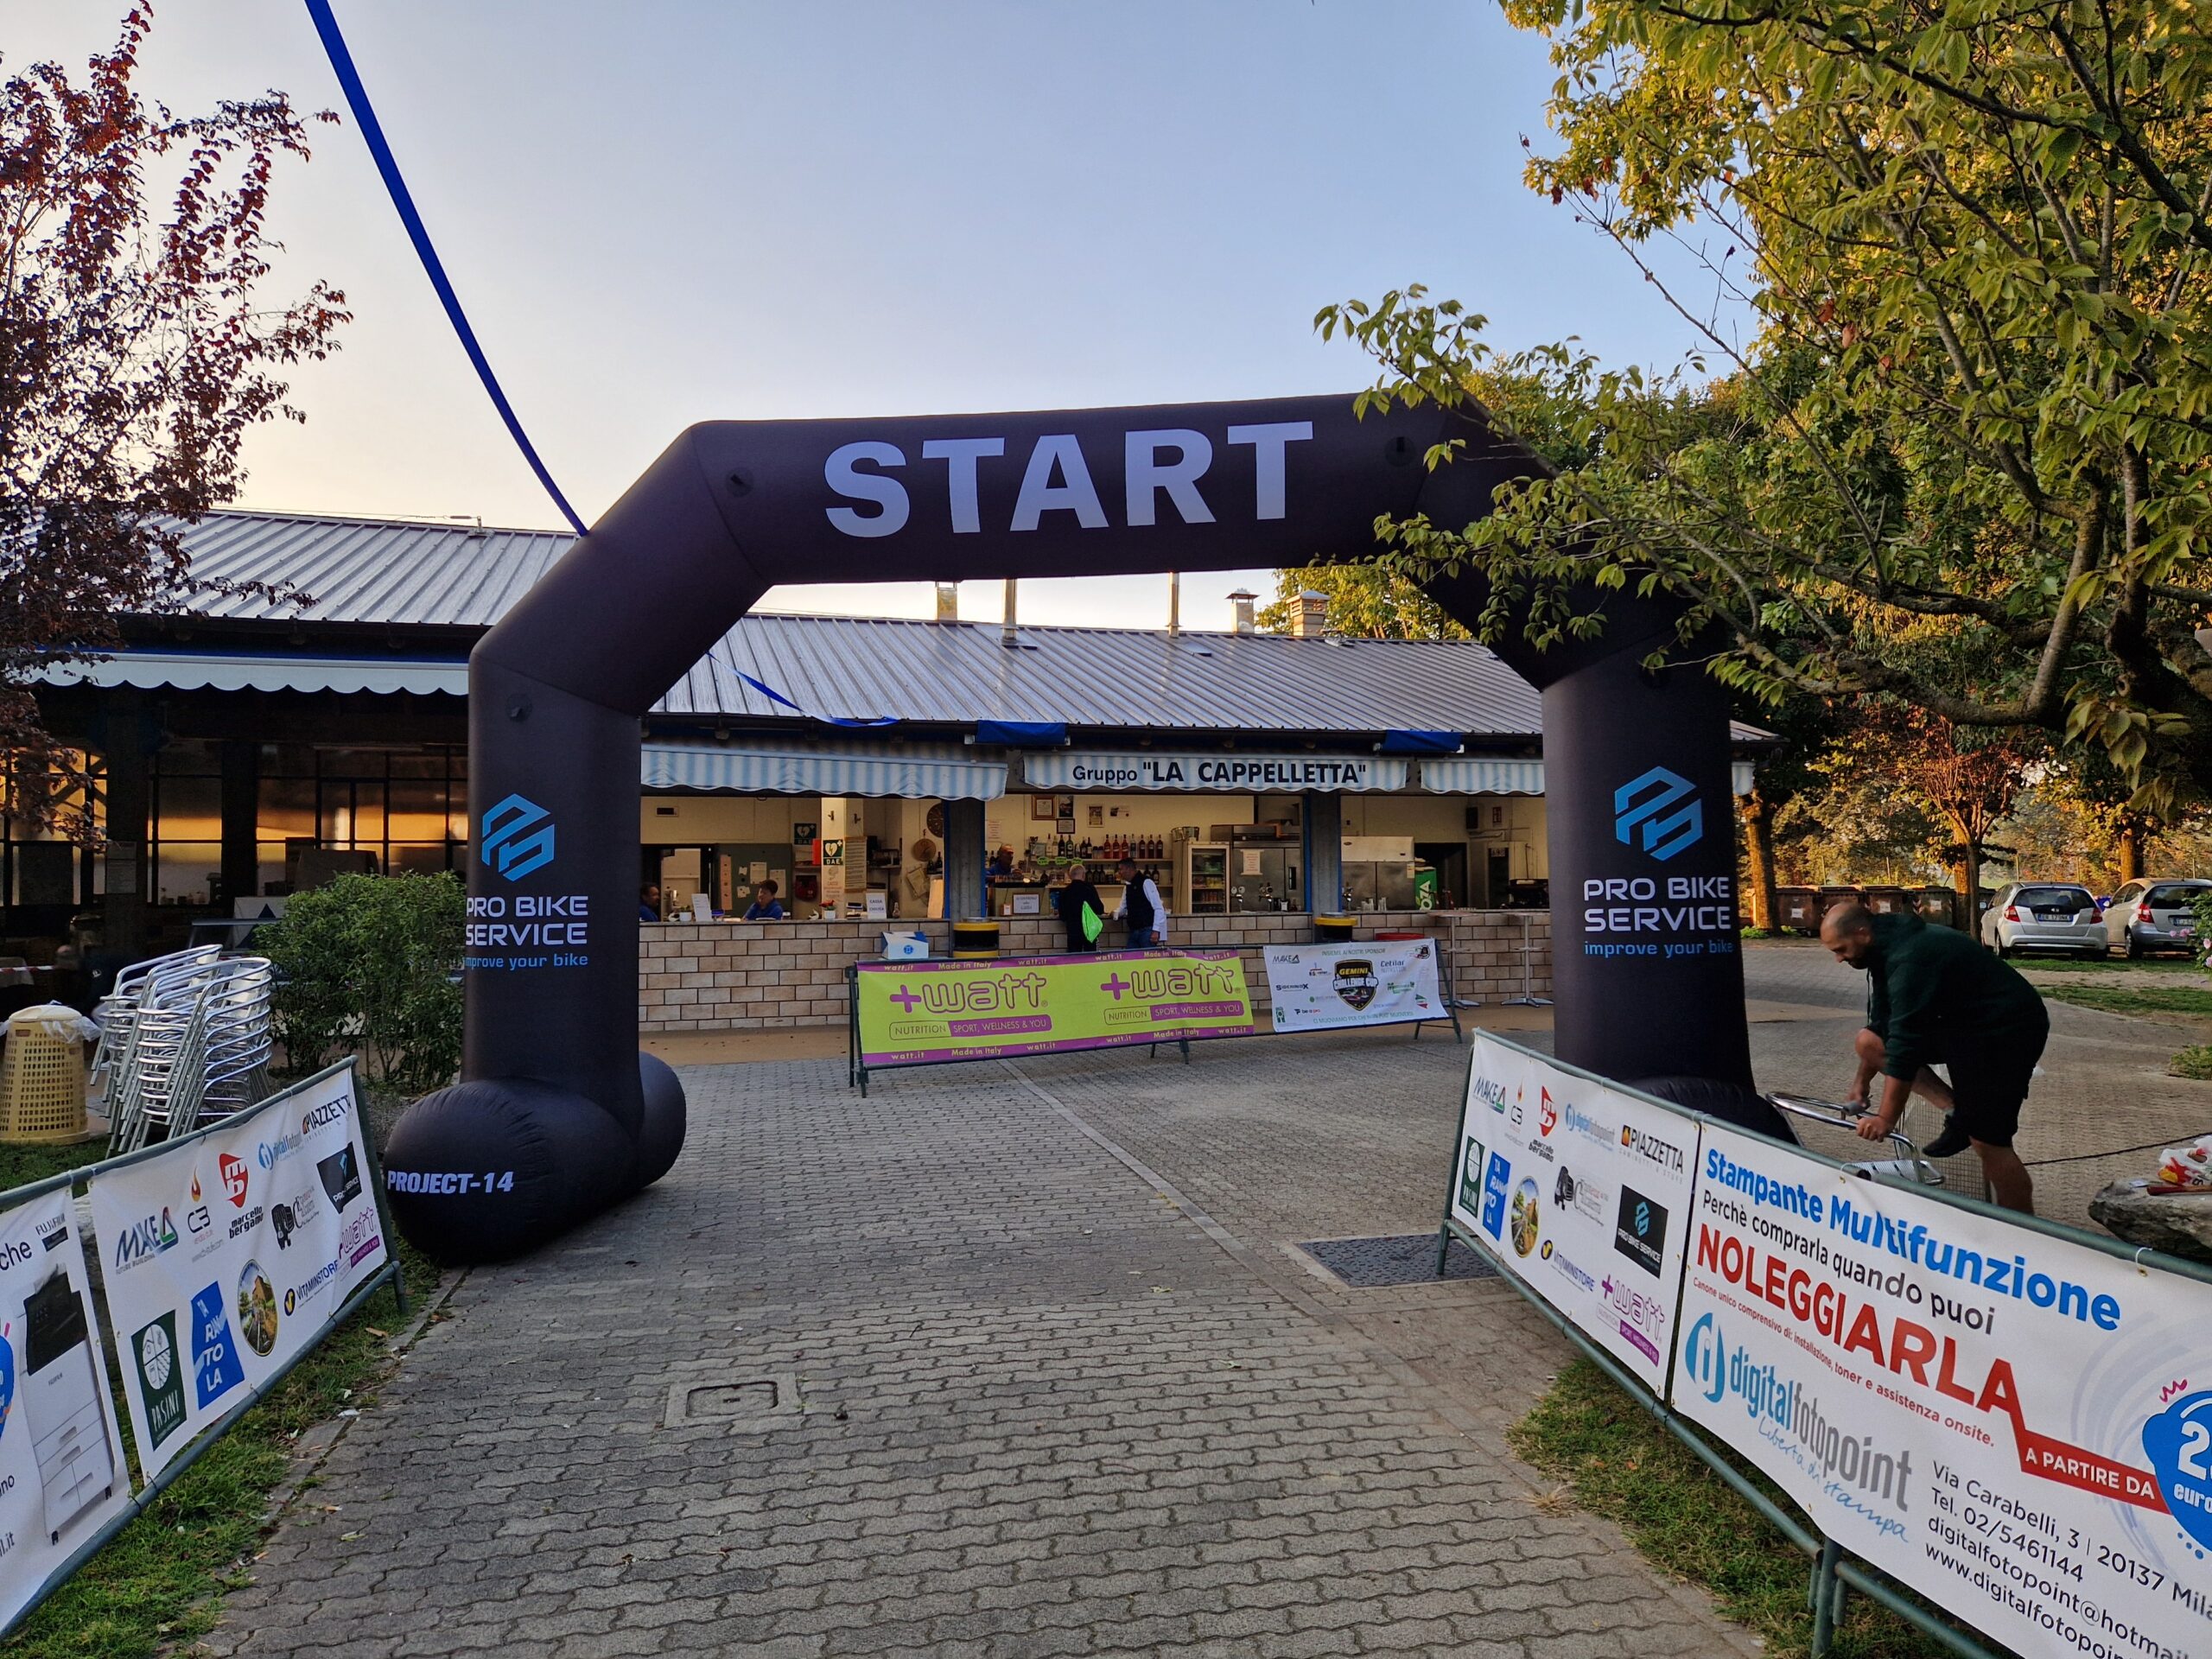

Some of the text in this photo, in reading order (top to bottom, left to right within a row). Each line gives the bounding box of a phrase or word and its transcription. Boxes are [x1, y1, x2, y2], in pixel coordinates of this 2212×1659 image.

[824, 421, 1313, 537] START
[1072, 761, 1366, 784] Gruppo "LA CAPPELLETTA"
[1584, 877, 1731, 901] PRO BIKE
[467, 895, 588, 917] PRO BIKE
[1584, 906, 1732, 932] SERVICE
[466, 922, 588, 946] SERVICE
[509, 957, 547, 970] your
[553, 953, 588, 967] bike
[1584, 939, 1733, 958] improve your bike
[938, 962, 962, 970] Made
[973, 961, 992, 969] Italy
[1109, 1009, 1147, 1020] NUTRITION
[1154, 1008, 1180, 1017] SPORT,
[1181, 1006, 1213, 1014] WELLNESS
[894, 1024, 947, 1035] NUTRITION
[953, 1023, 980, 1033] SPORT,
[982, 1020, 1020, 1032] WELLNESS
[1029, 1019, 1047, 1028] YOU
[891, 1051, 925, 1061] watt.it
[951, 1048, 974, 1058] Made
[975, 1047, 983, 1056] in
[985, 1046, 1002, 1057] Italy
[1027, 1043, 1057, 1052] watt.it
[1183, 1028, 1199, 1037] Italy
[1528, 1142, 1554, 1163] bergamo
[1532, 1139, 1554, 1154] marcello
[1630, 1128, 1683, 1174] PIAZZETTA
[387, 1170, 514, 1194] PROJECT-14
[188, 1205, 211, 1234] C3
[231, 1206, 263, 1228] marcello
[1618, 1227, 1629, 1242] PRO
[1628, 1235, 1640, 1249] BIKE
[1639, 1242, 1662, 1263] SERVICE
[1705, 1147, 1823, 1223] Stampante
[1828, 1195, 2121, 1332] Multifunzione
[1703, 1189, 1995, 1335] Perchè comprarla quando puoi
[1697, 1223, 2026, 1417] NOLEGGIARLA
[203, 1343, 225, 1367] TO
[1693, 1276, 1996, 1448] Canone unico comprensivo di: installazione, toner e assistenza onsite.
[206, 1367, 223, 1393] LA
[151, 1389, 180, 1432] PASINI
[1730, 1344, 1913, 1513] digitalfotopoint
[2177, 1420, 2212, 1481] 2
[2025, 1447, 2156, 1501] A PARTIRE DA
[1823, 1479, 1910, 1543] stampa
[1931, 1486, 2084, 1583] Tel. 02/5461144
[1933, 1459, 1960, 1491] Via
[1966, 1479, 2061, 1544] Carabelli,
[2068, 1528, 2081, 1550] 3
[2097, 1544, 2166, 1592] 20137
